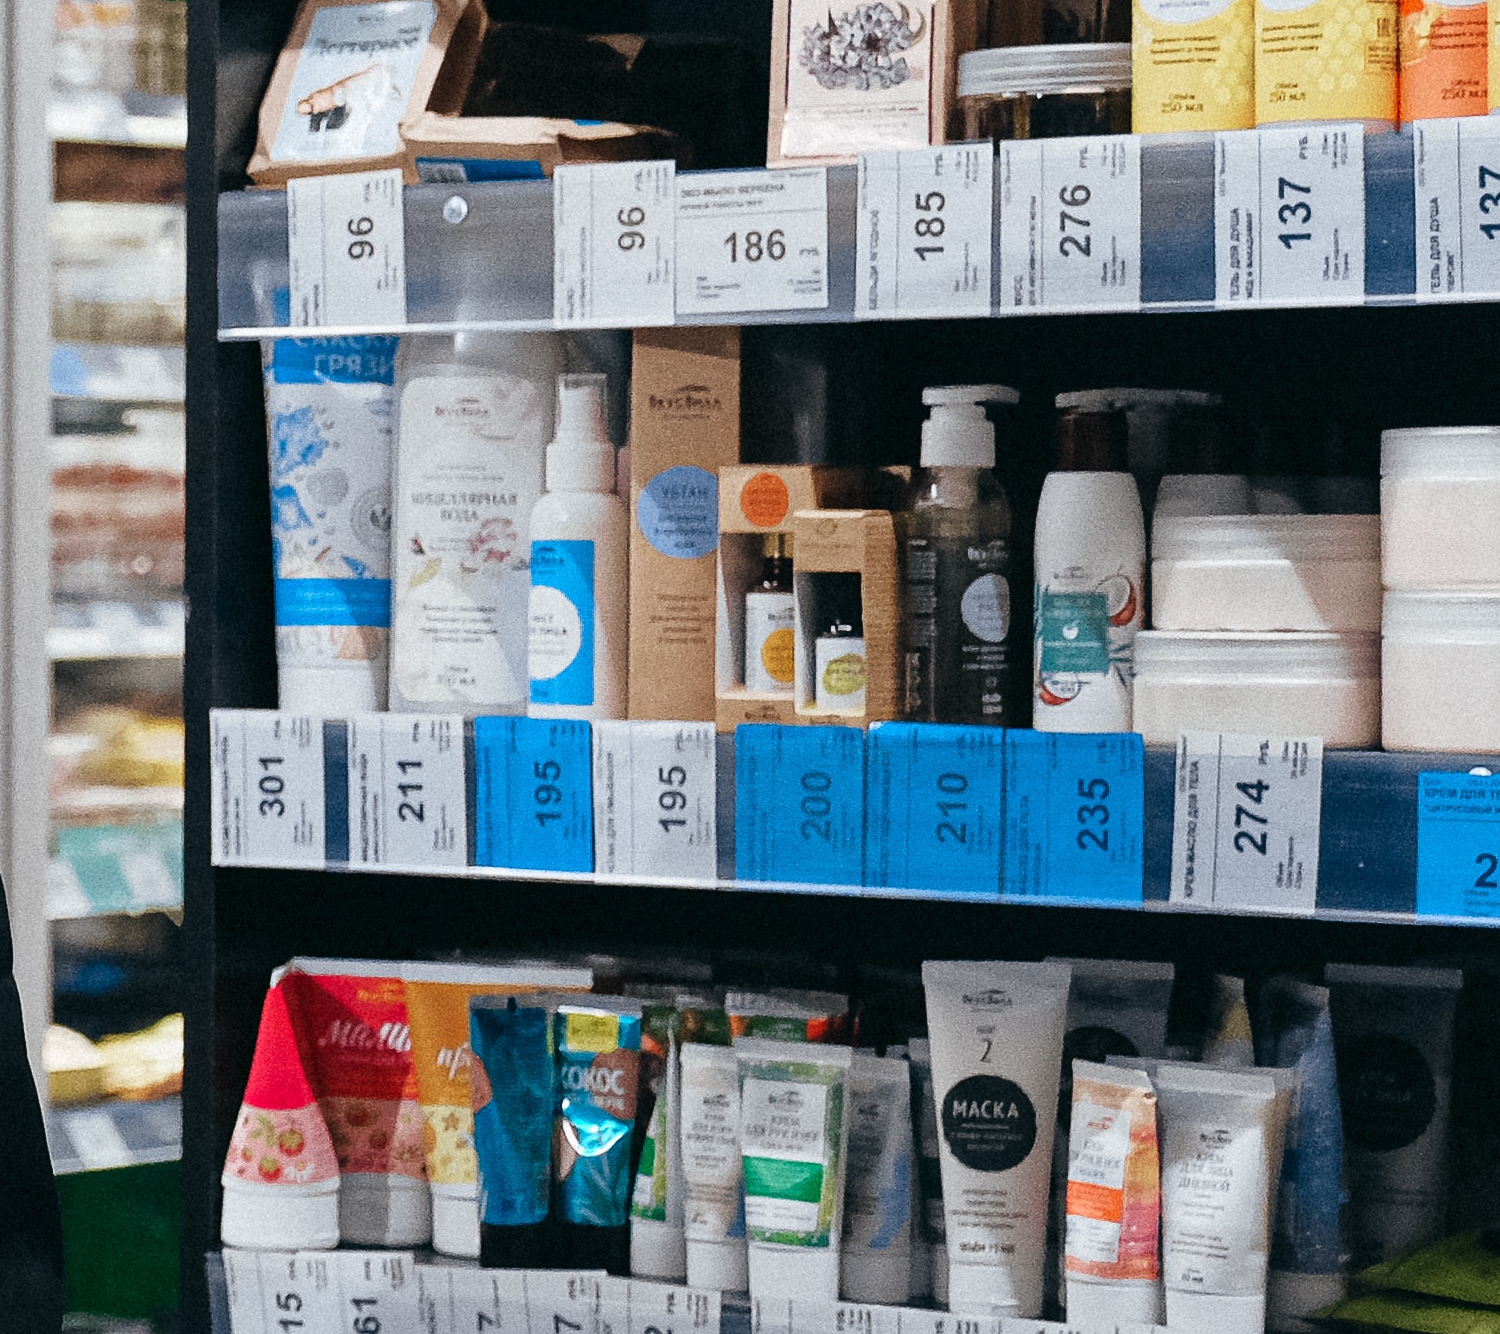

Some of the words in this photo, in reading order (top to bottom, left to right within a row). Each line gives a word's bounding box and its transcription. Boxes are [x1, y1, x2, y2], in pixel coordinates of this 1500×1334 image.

[346, 215, 375, 261] 96
[617, 205, 646, 251] 96
[722, 228, 787, 264] 186
[914, 191, 946, 263] 185
[1058, 183, 1092, 260] 276
[1278, 176, 1312, 251] 137
[258, 756, 285, 818] 301
[397, 760, 425, 823] 211
[533, 760, 563, 828] 195
[657, 764, 687, 834] 195
[800, 770, 833, 842] 200
[934, 773, 968, 845] 210
[1076, 777, 1111, 852] 235
[1232, 778, 1270, 856] 274
[977, 1038, 992, 1065] 2
[952, 1098, 1020, 1119] МАСКА
